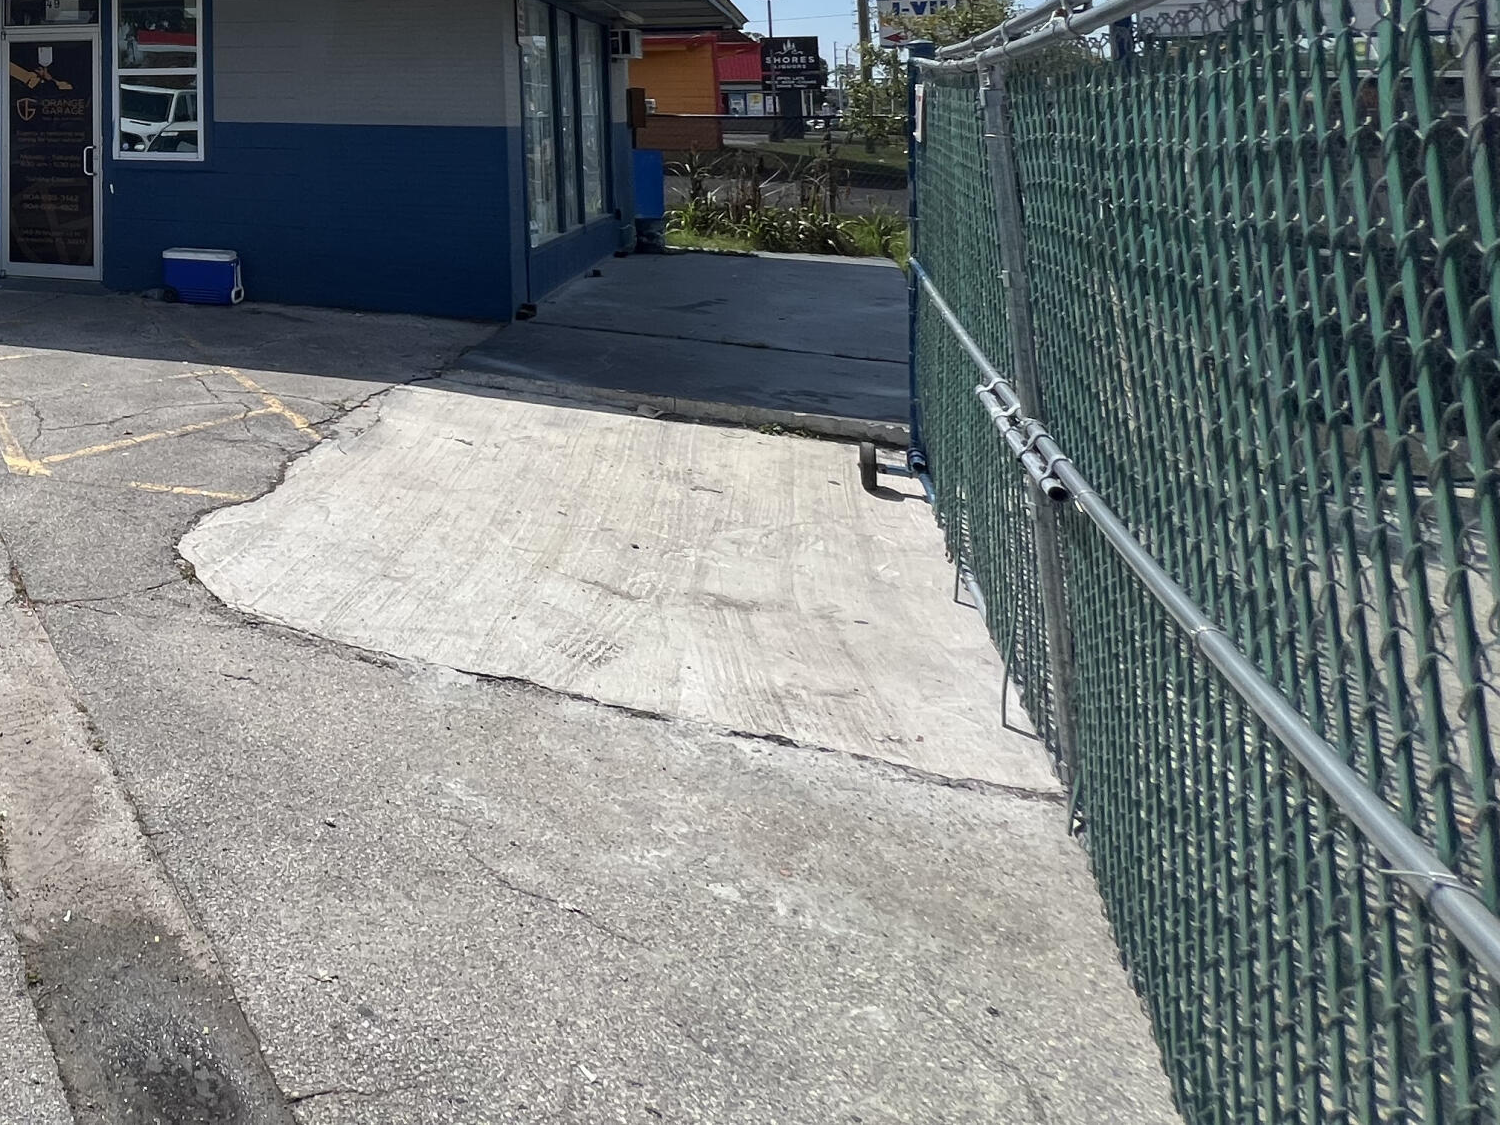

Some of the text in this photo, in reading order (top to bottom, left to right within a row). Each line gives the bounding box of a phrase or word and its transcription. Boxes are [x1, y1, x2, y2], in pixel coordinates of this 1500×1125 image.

[765, 56, 815, 64] SHORES
[42, 98, 85, 107] ORANGE
[42, 106, 85, 115] GARAGE
